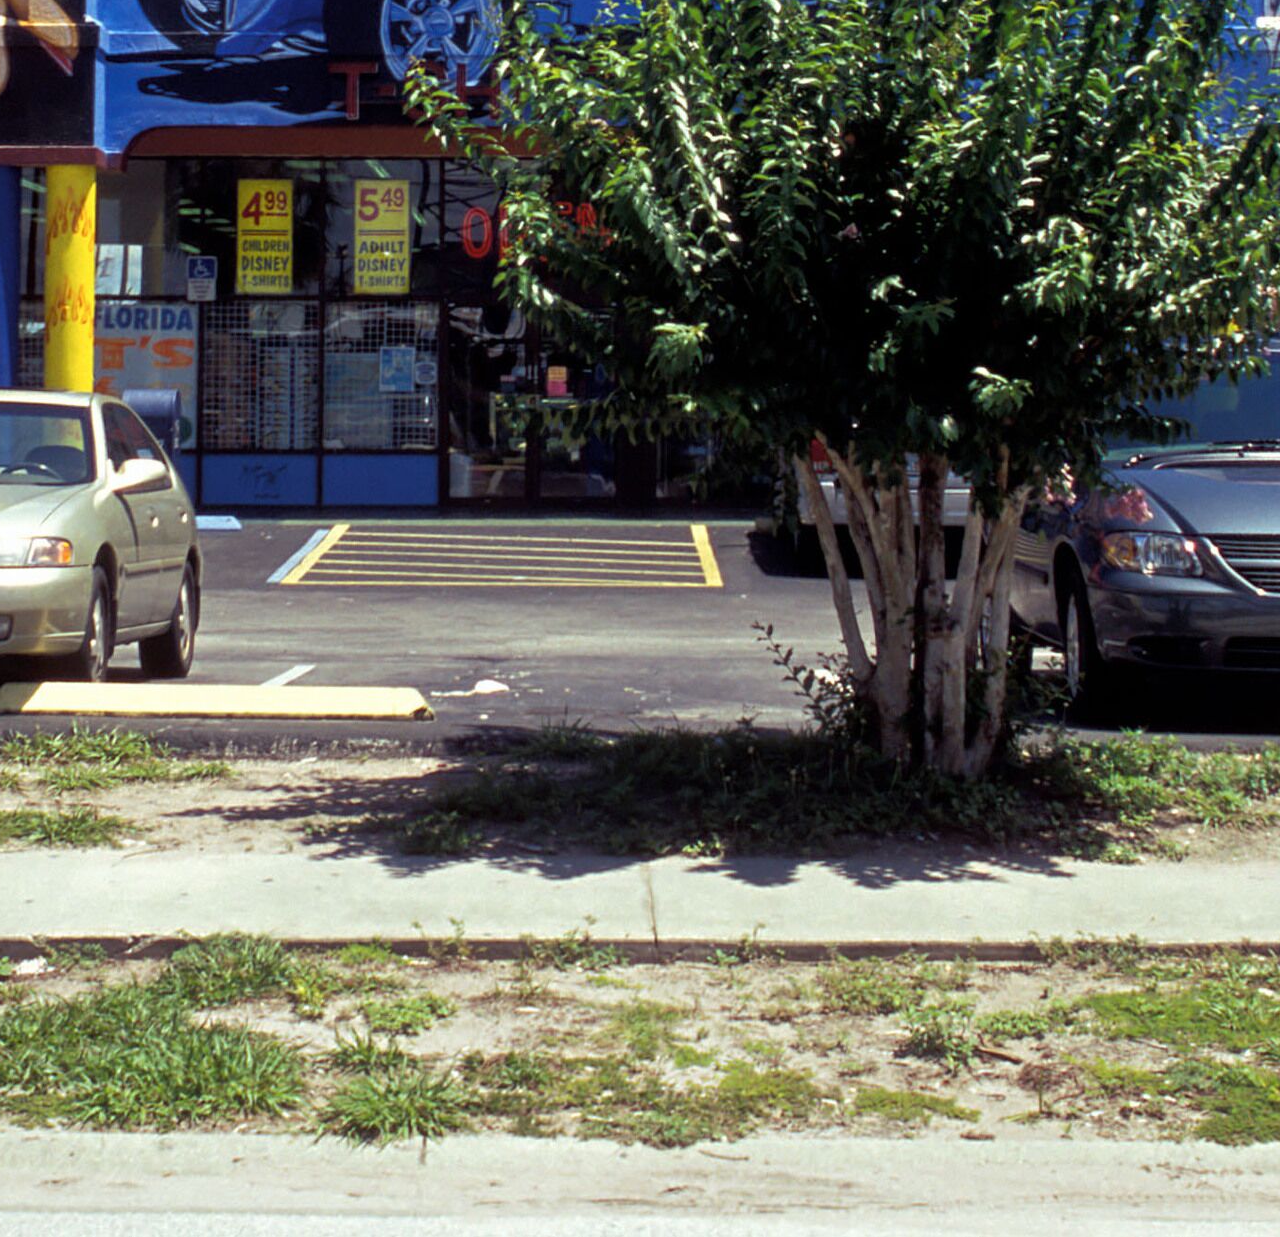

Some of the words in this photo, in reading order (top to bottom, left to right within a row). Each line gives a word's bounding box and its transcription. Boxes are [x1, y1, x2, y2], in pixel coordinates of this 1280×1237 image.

[242, 240, 290, 253] CHILDREN
[359, 241, 405, 254] ADULT
[241, 256, 289, 272] DISNEY
[358, 258, 407, 272] DISNEY
[242, 275, 290, 288] T-SHIRTS
[358, 275, 407, 288] T-SHIRTS
